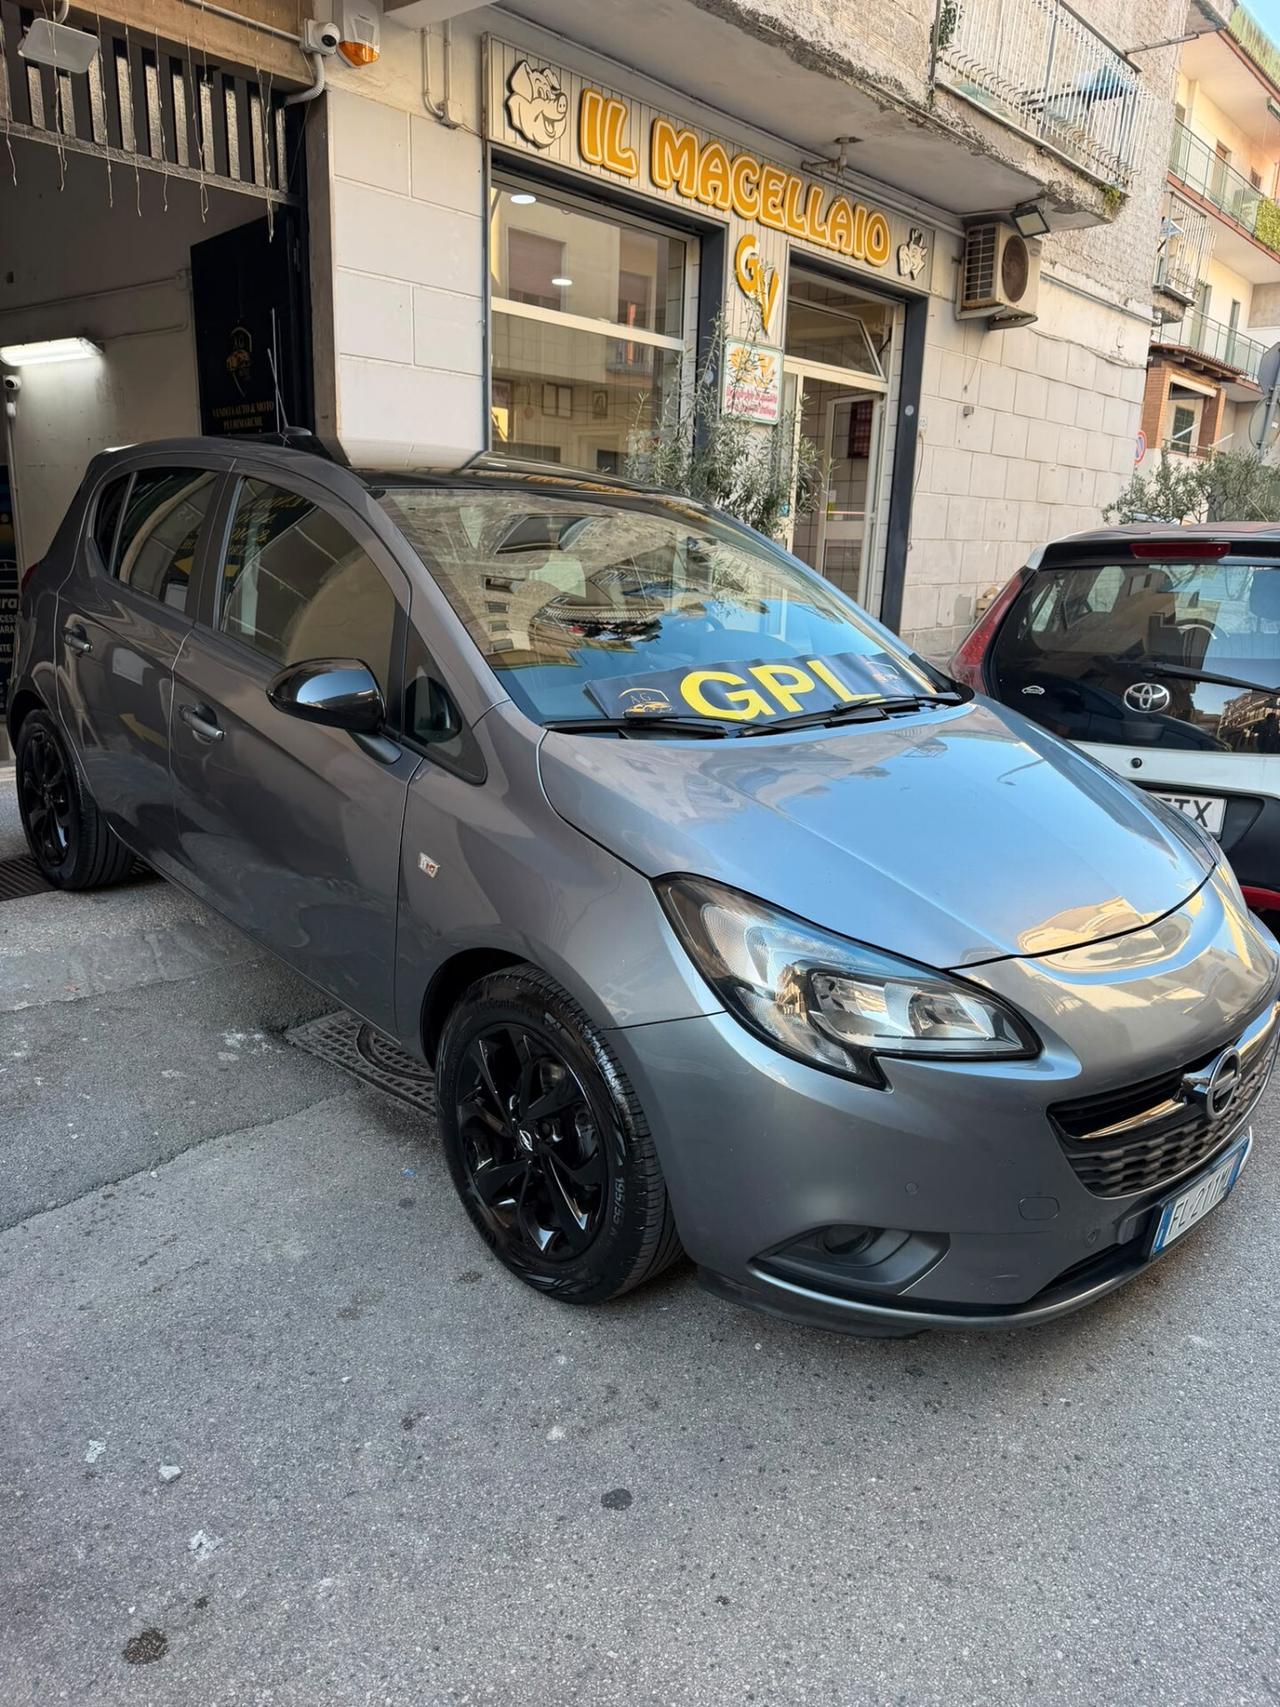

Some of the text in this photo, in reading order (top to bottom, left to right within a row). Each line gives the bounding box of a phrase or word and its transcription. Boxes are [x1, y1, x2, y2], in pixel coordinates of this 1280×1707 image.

[580, 89, 891, 266] IL MACELLAIO
[681, 660, 883, 721] GPL
